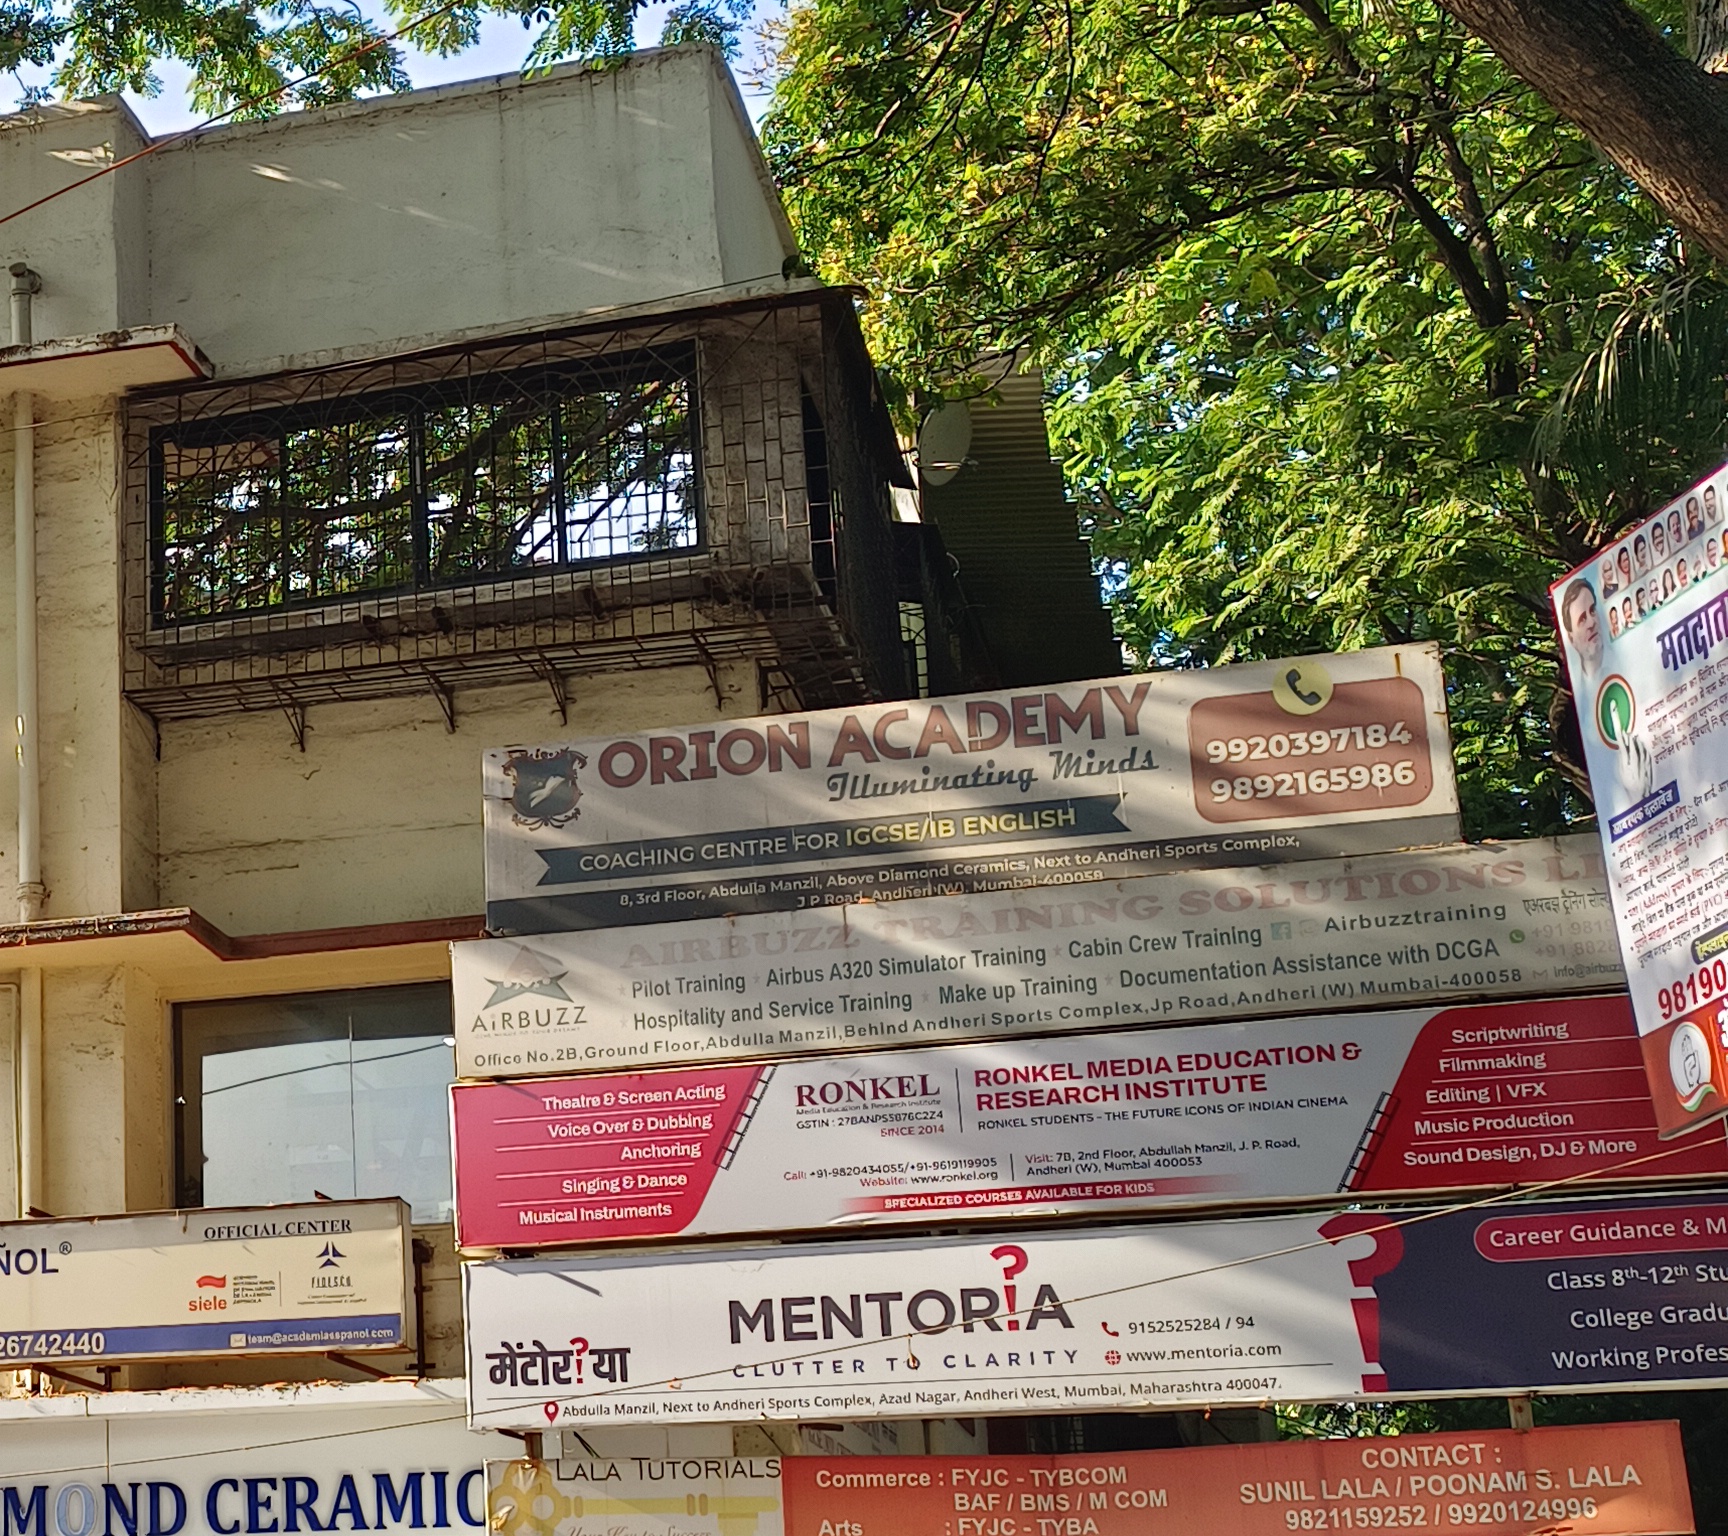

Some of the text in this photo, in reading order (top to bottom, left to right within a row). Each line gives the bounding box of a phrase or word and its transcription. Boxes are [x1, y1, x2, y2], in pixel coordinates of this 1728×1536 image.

[598, 681, 1152, 789] ORION ACADEMY
[1206, 721, 1412, 764] 9920397184
[827, 746, 1159, 802] Illuminating Minds
[1210, 761, 1415, 802] 9892165986
[580, 806, 1076, 872] COACHING CENTRE FOR IGCSE/IB ENGLISH
[827, 841, 1217, 886] Above Next Sports
[622, 855, 1527, 970] AIRBUZZ TRAINING SOLUTIONS
[632, 903, 1506, 999] Pilot Training Airbus A320 Simulator Training Cabin Crew Training Airbuzztraining
[634, 938, 1499, 1032] Hospitality and Service Training Make Training Documentation Assistance with DCGA
[991, 1006, 1045, 1028] Sports
[1452, 1023, 1569, 1044] Scriptwriting
[974, 1043, 1336, 1087] RONKEL MEDIA EDUCATION
[1439, 1052, 1547, 1073] Filmmaking
[542, 1083, 726, 1112] Theatre Screen Acting
[794, 1073, 941, 1108] RONKEL
[977, 1073, 1267, 1111] RESEARCH INSTITUTE
[1425, 1082, 1548, 1104] Editing VFX
[1030, 1096, 1348, 1126] STUDENTS FUTURE INDIAN CINEMA
[1414, 1111, 1574, 1136] Music Production
[548, 1112, 714, 1139] Voice Over Dubbing
[620, 1141, 702, 1161] Anchoring
[1404, 1138, 1637, 1166] Sound Design, More
[562, 1172, 687, 1196] Singing Dance
[884, 1191, 1022, 1209] SPECIALIZED COURSES
[519, 1202, 672, 1226] Musical Instruments
[204, 1219, 352, 1240] OFFICIAL CENTER
[1490, 1219, 1675, 1248] Career Guidance
[1547, 1271, 1606, 1291] Class
[189, 1295, 227, 1312] siele
[1128, 1315, 1255, 1335] 9152525284 94
[1570, 1308, 1654, 1330] College
[733, 1349, 1078, 1378] CLUTTER CLARITY
[1126, 1342, 1282, 1363] www.mentoria.com
[1552, 1347, 1650, 1370] Working
[768, 1379, 1222, 1411] Sports Azad Andheri Maharashtra
[1361, 1443, 1485, 1469] CONTACT
[557, 1457, 782, 1482] LALA TUTORIALS
[815, 1466, 1127, 1488] Commerce FYJC TYBCOM
[1240, 1463, 1642, 1505] SUNIL LALA POONAM LALA
[954, 1489, 1167, 1512] BAF BMS COM
[1285, 1496, 1598, 1531] 9821159252 9920124996
[818, 1517, 1099, 1536] Arts FYJC TYBA
